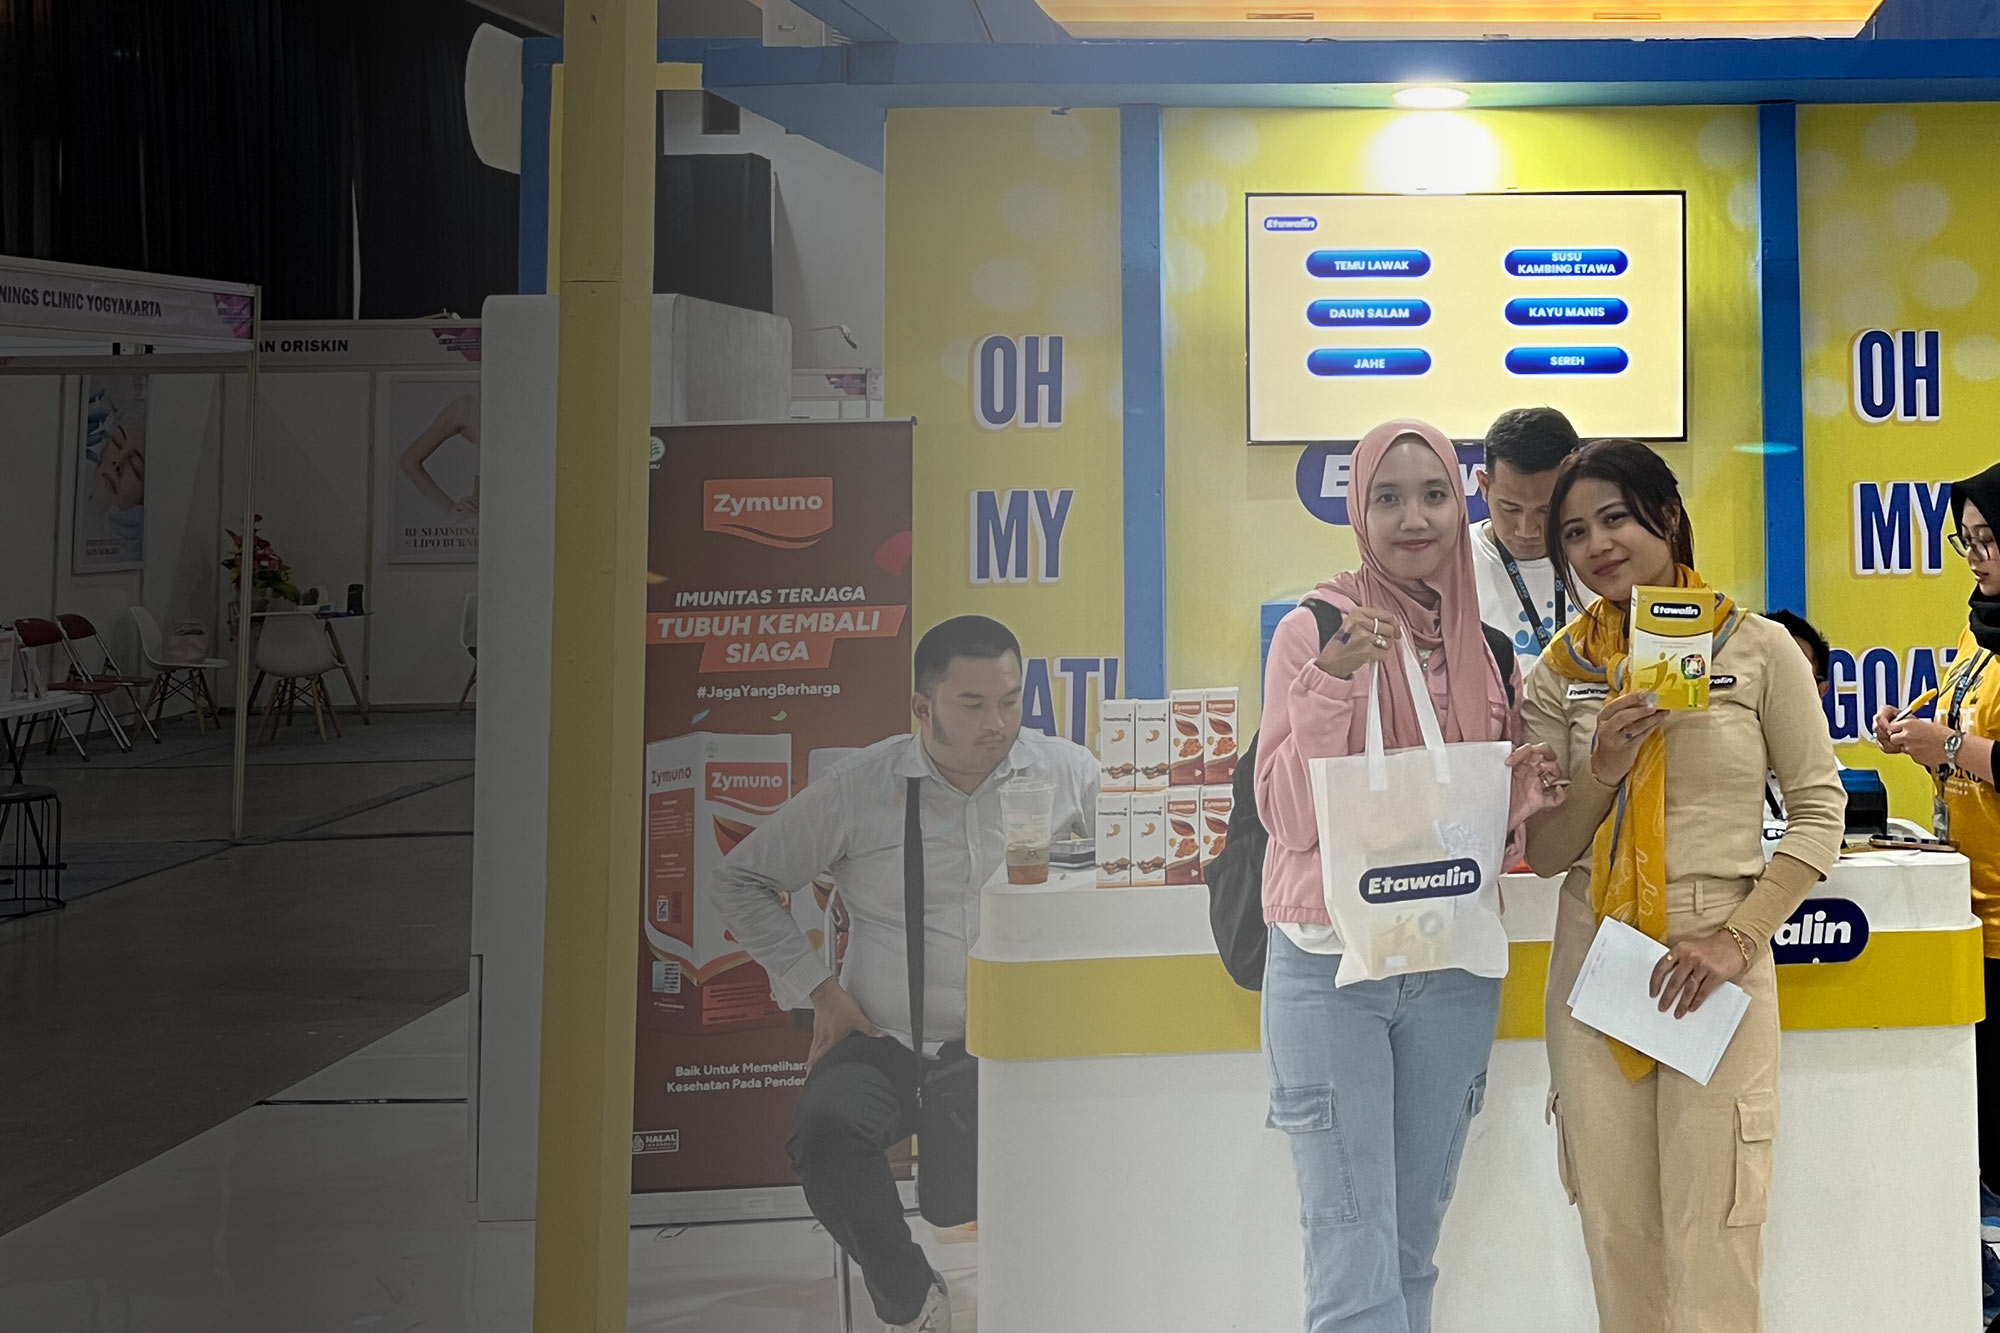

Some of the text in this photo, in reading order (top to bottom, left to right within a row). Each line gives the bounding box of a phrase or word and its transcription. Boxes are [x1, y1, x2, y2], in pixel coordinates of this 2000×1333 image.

[1334, 259, 1410, 271] TEMU LAWAK
[1551, 251, 1582, 262] SUSU
[1517, 264, 1616, 274] KAMBING ETAWA
[43, 290, 84, 311] CLINIC
[86, 294, 162, 317] YOGYAKARTA
[1329, 308, 1410, 319] DAUN SALAM
[1528, 306, 1606, 318] KAYU MANIS
[280, 339, 349, 353] ORISKIN
[1353, 357, 1386, 369] JAHE
[1550, 355, 1585, 366] SEREH
[977, 334, 1064, 427] OH
[1856, 329, 1941, 420] OH
[713, 493, 824, 517] Zymuno
[972, 489, 1074, 581] MY
[1855, 481, 1956, 572] MY
[443, 538, 478, 547] BURN
[675, 586, 866, 607] IMUNITAS TERJAGA
[1653, 605, 1699, 616] Etawalin
[657, 610, 881, 639] TUBUH KEMBALI
[725, 640, 810, 664] SIAGA
[697, 683, 841, 701] #JagaYangBerharga
[1021, 656, 1120, 747] AT!
[1828, 647, 1959, 743] GOA
[650, 766, 692, 788] Zymuno
[711, 771, 783, 793] Zymuno
[1367, 865, 1475, 895] Etawalin
[1774, 910, 1852, 946] alin
[675, 1060, 807, 1077] Baik Untuk Memelihar
[666, 1075, 806, 1093] Kesehatan Pada Pender
[645, 1133, 677, 1143] HALAL
